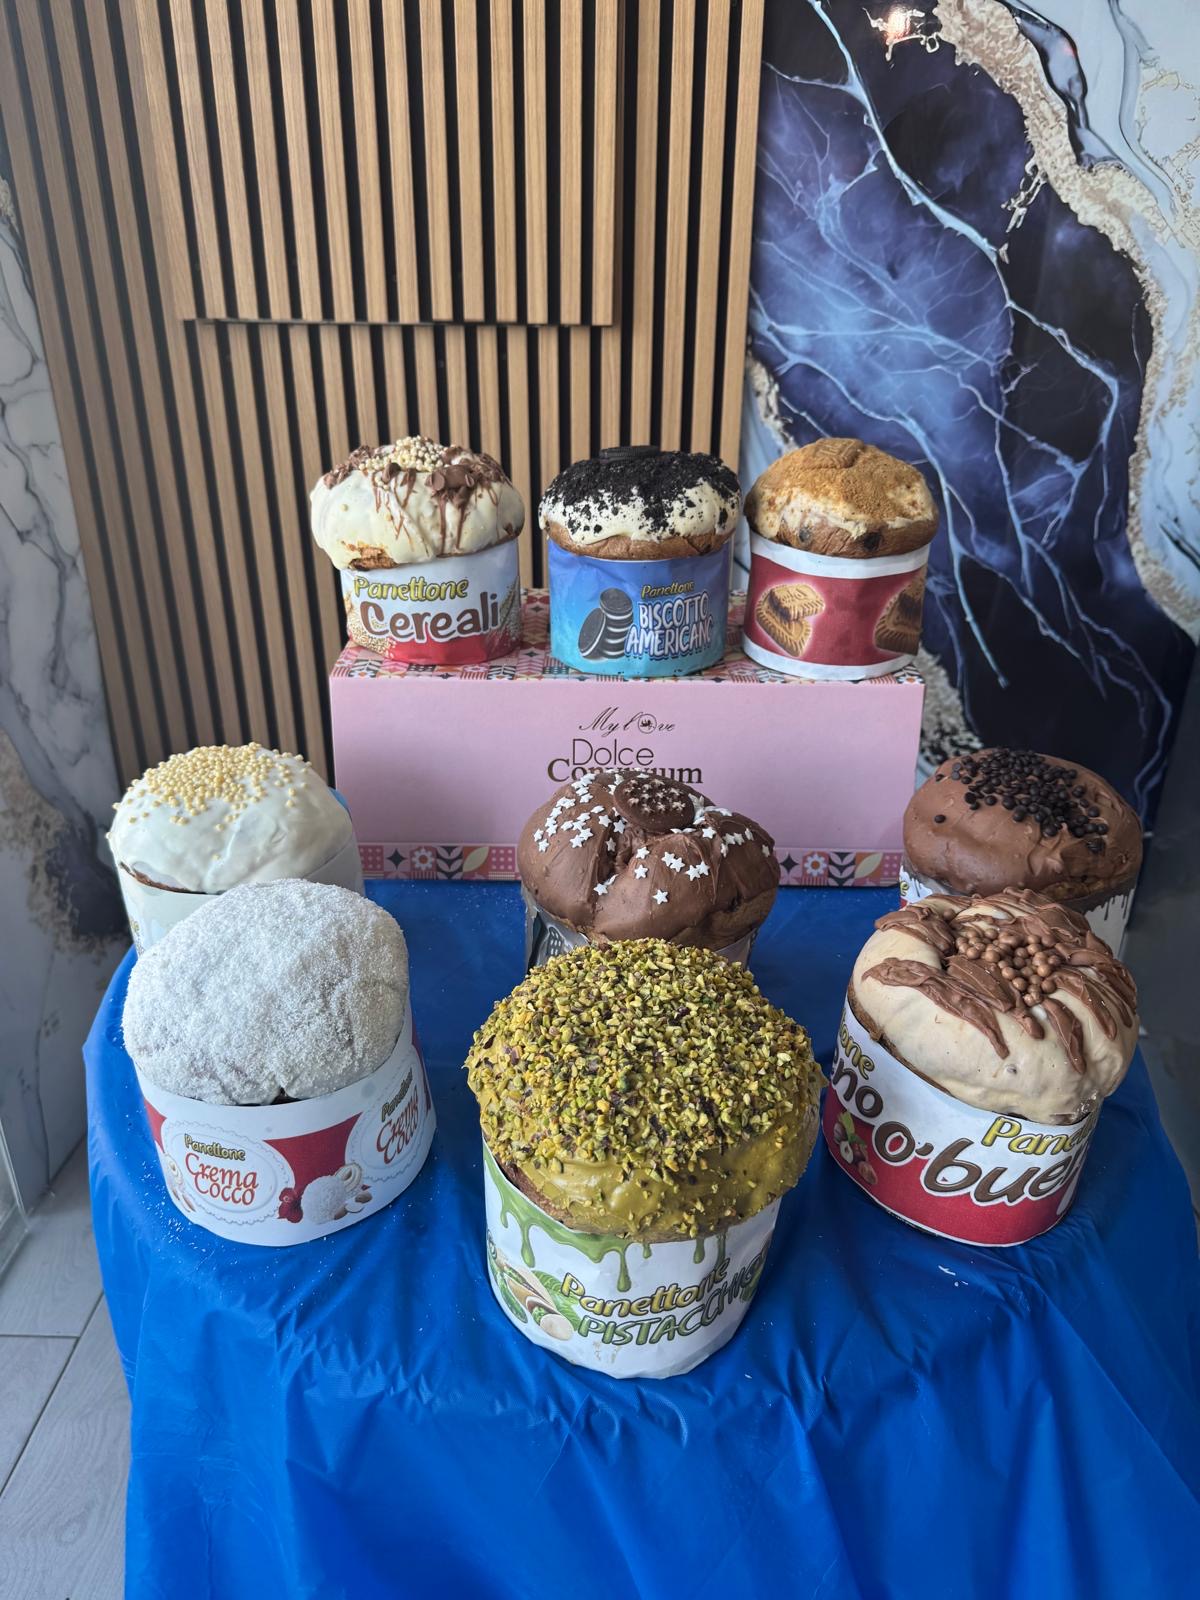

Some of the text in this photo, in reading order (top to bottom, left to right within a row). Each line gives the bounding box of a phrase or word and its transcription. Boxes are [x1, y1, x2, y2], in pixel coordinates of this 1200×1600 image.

[353, 575, 469, 602] Panettone
[641, 580, 696, 600] Panettone
[359, 591, 500, 641] Cereali
[637, 591, 711, 631] BISCOTTO
[578, 706, 620, 737] My
[572, 738, 654, 766] Dolce
[184, 1133, 246, 1161] Panettone
[185, 1152, 260, 1190] Crema
[194, 1173, 256, 1206] Cocco
[561, 1256, 730, 1319] Panettone
